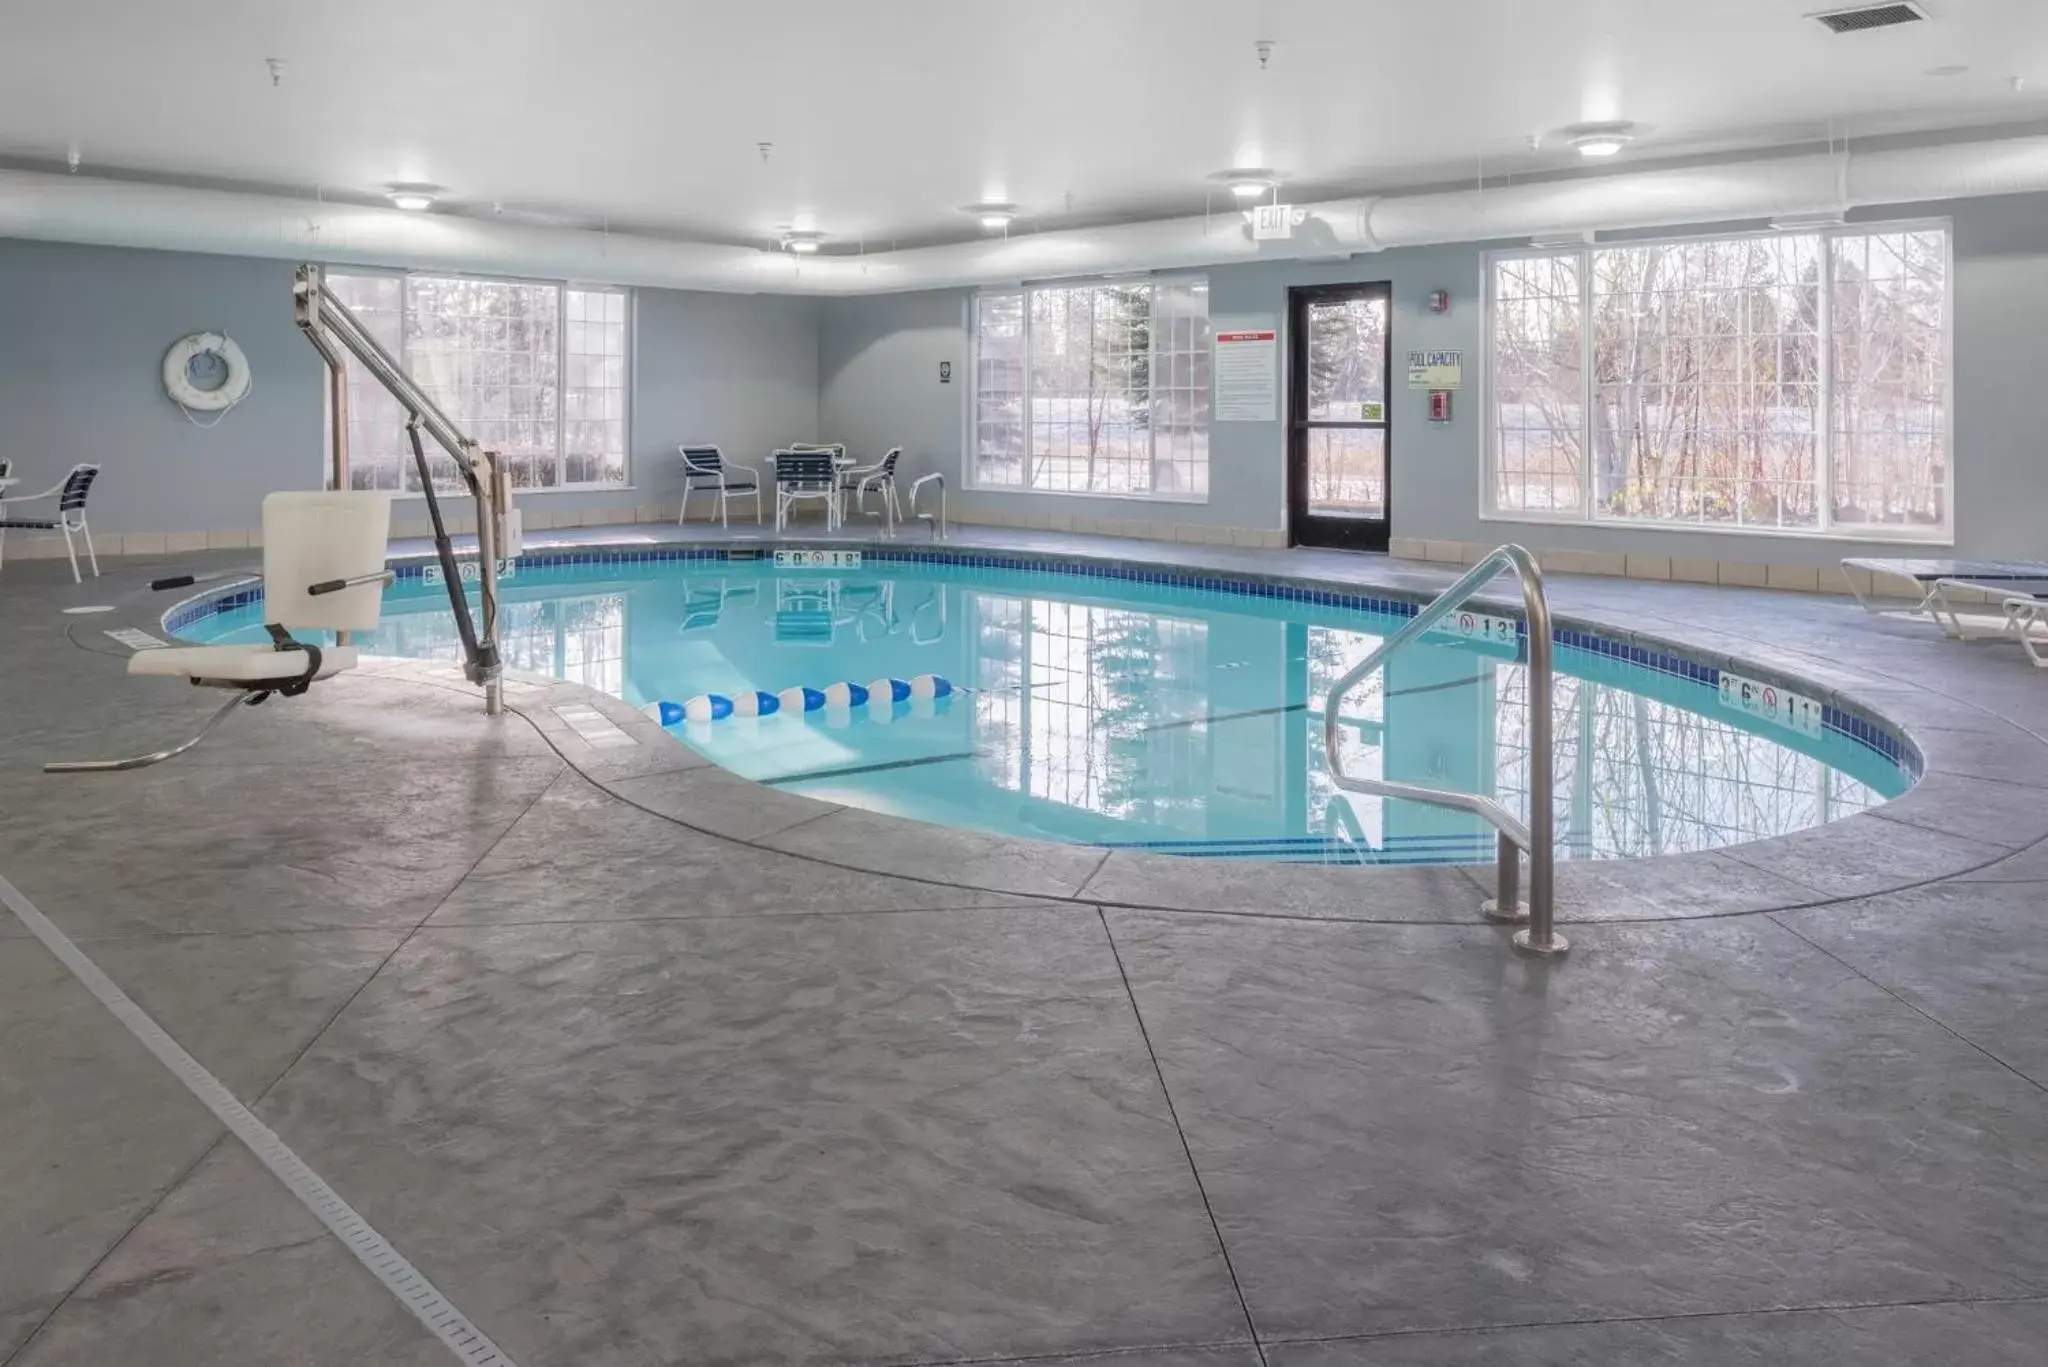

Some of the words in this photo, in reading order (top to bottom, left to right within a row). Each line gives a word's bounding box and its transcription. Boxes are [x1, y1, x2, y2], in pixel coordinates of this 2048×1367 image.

[1260, 208, 1285, 231] EXIT
[1409, 351, 1425, 367] POOL
[1427, 351, 1461, 367] CAPACITY
